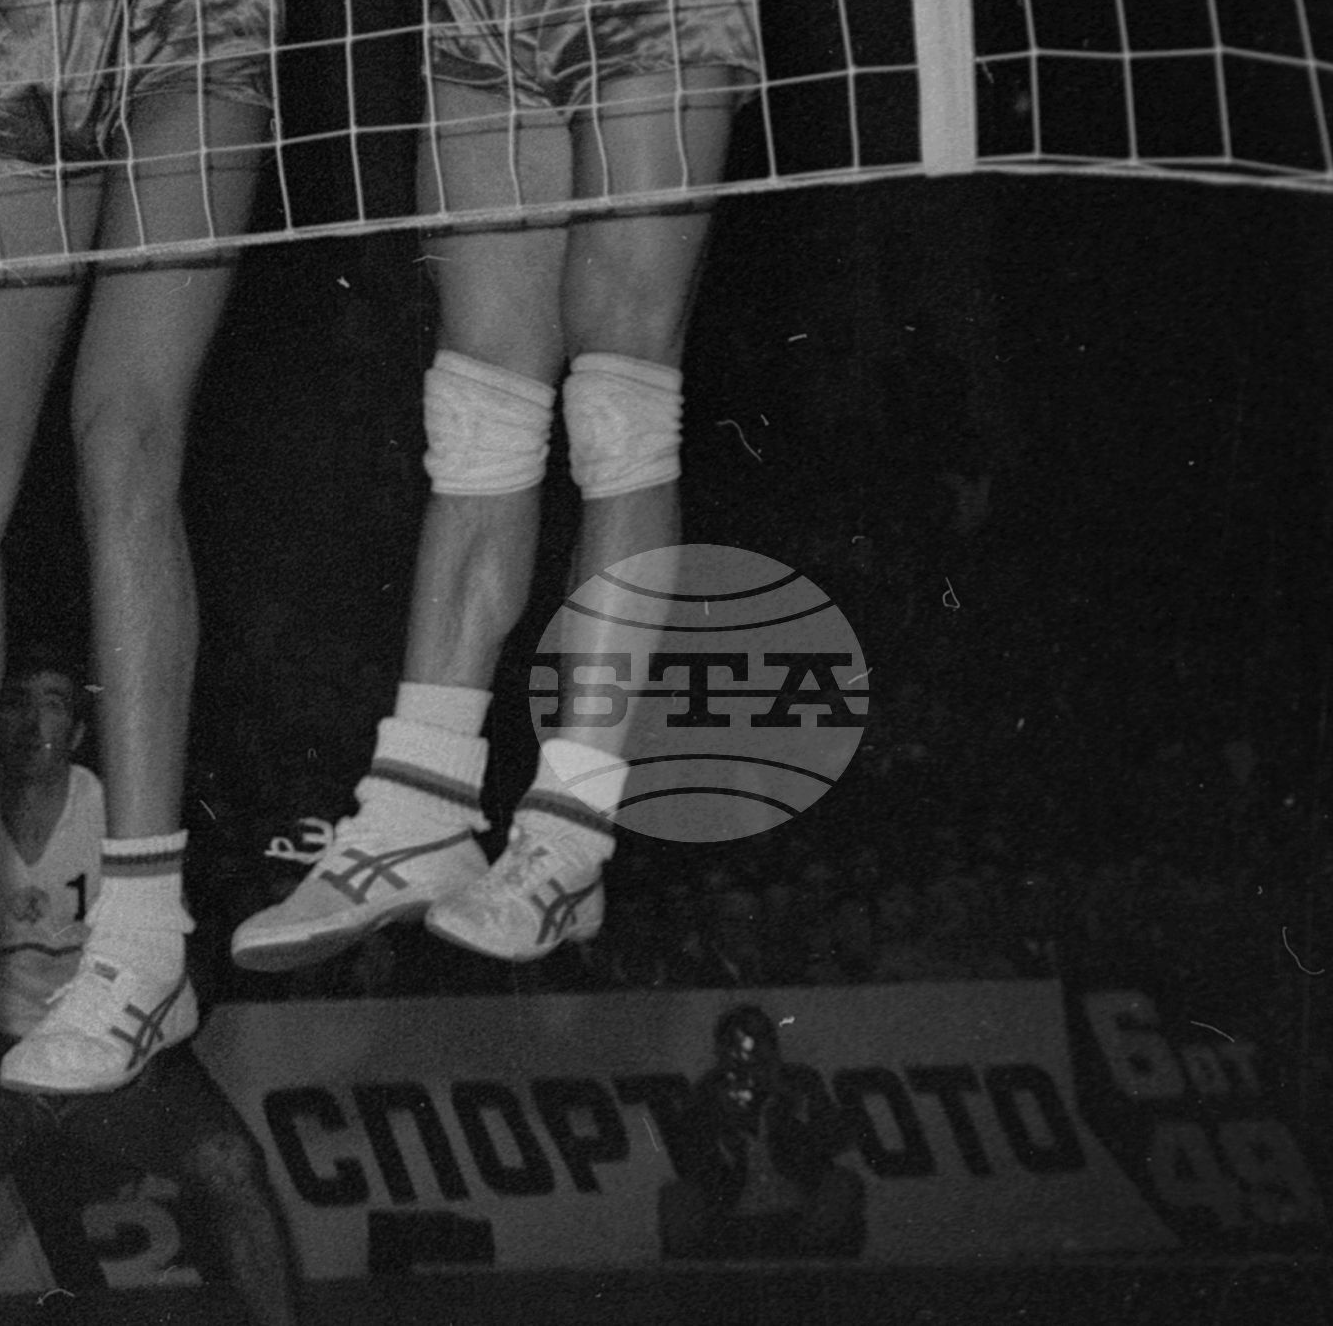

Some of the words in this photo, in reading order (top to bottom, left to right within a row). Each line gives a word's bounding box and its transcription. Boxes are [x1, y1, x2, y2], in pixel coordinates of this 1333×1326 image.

[65, 872, 87, 922] 1
[262, 1071, 695, 1207] СПОРТ
[831, 1062, 1087, 1179] ОТО
